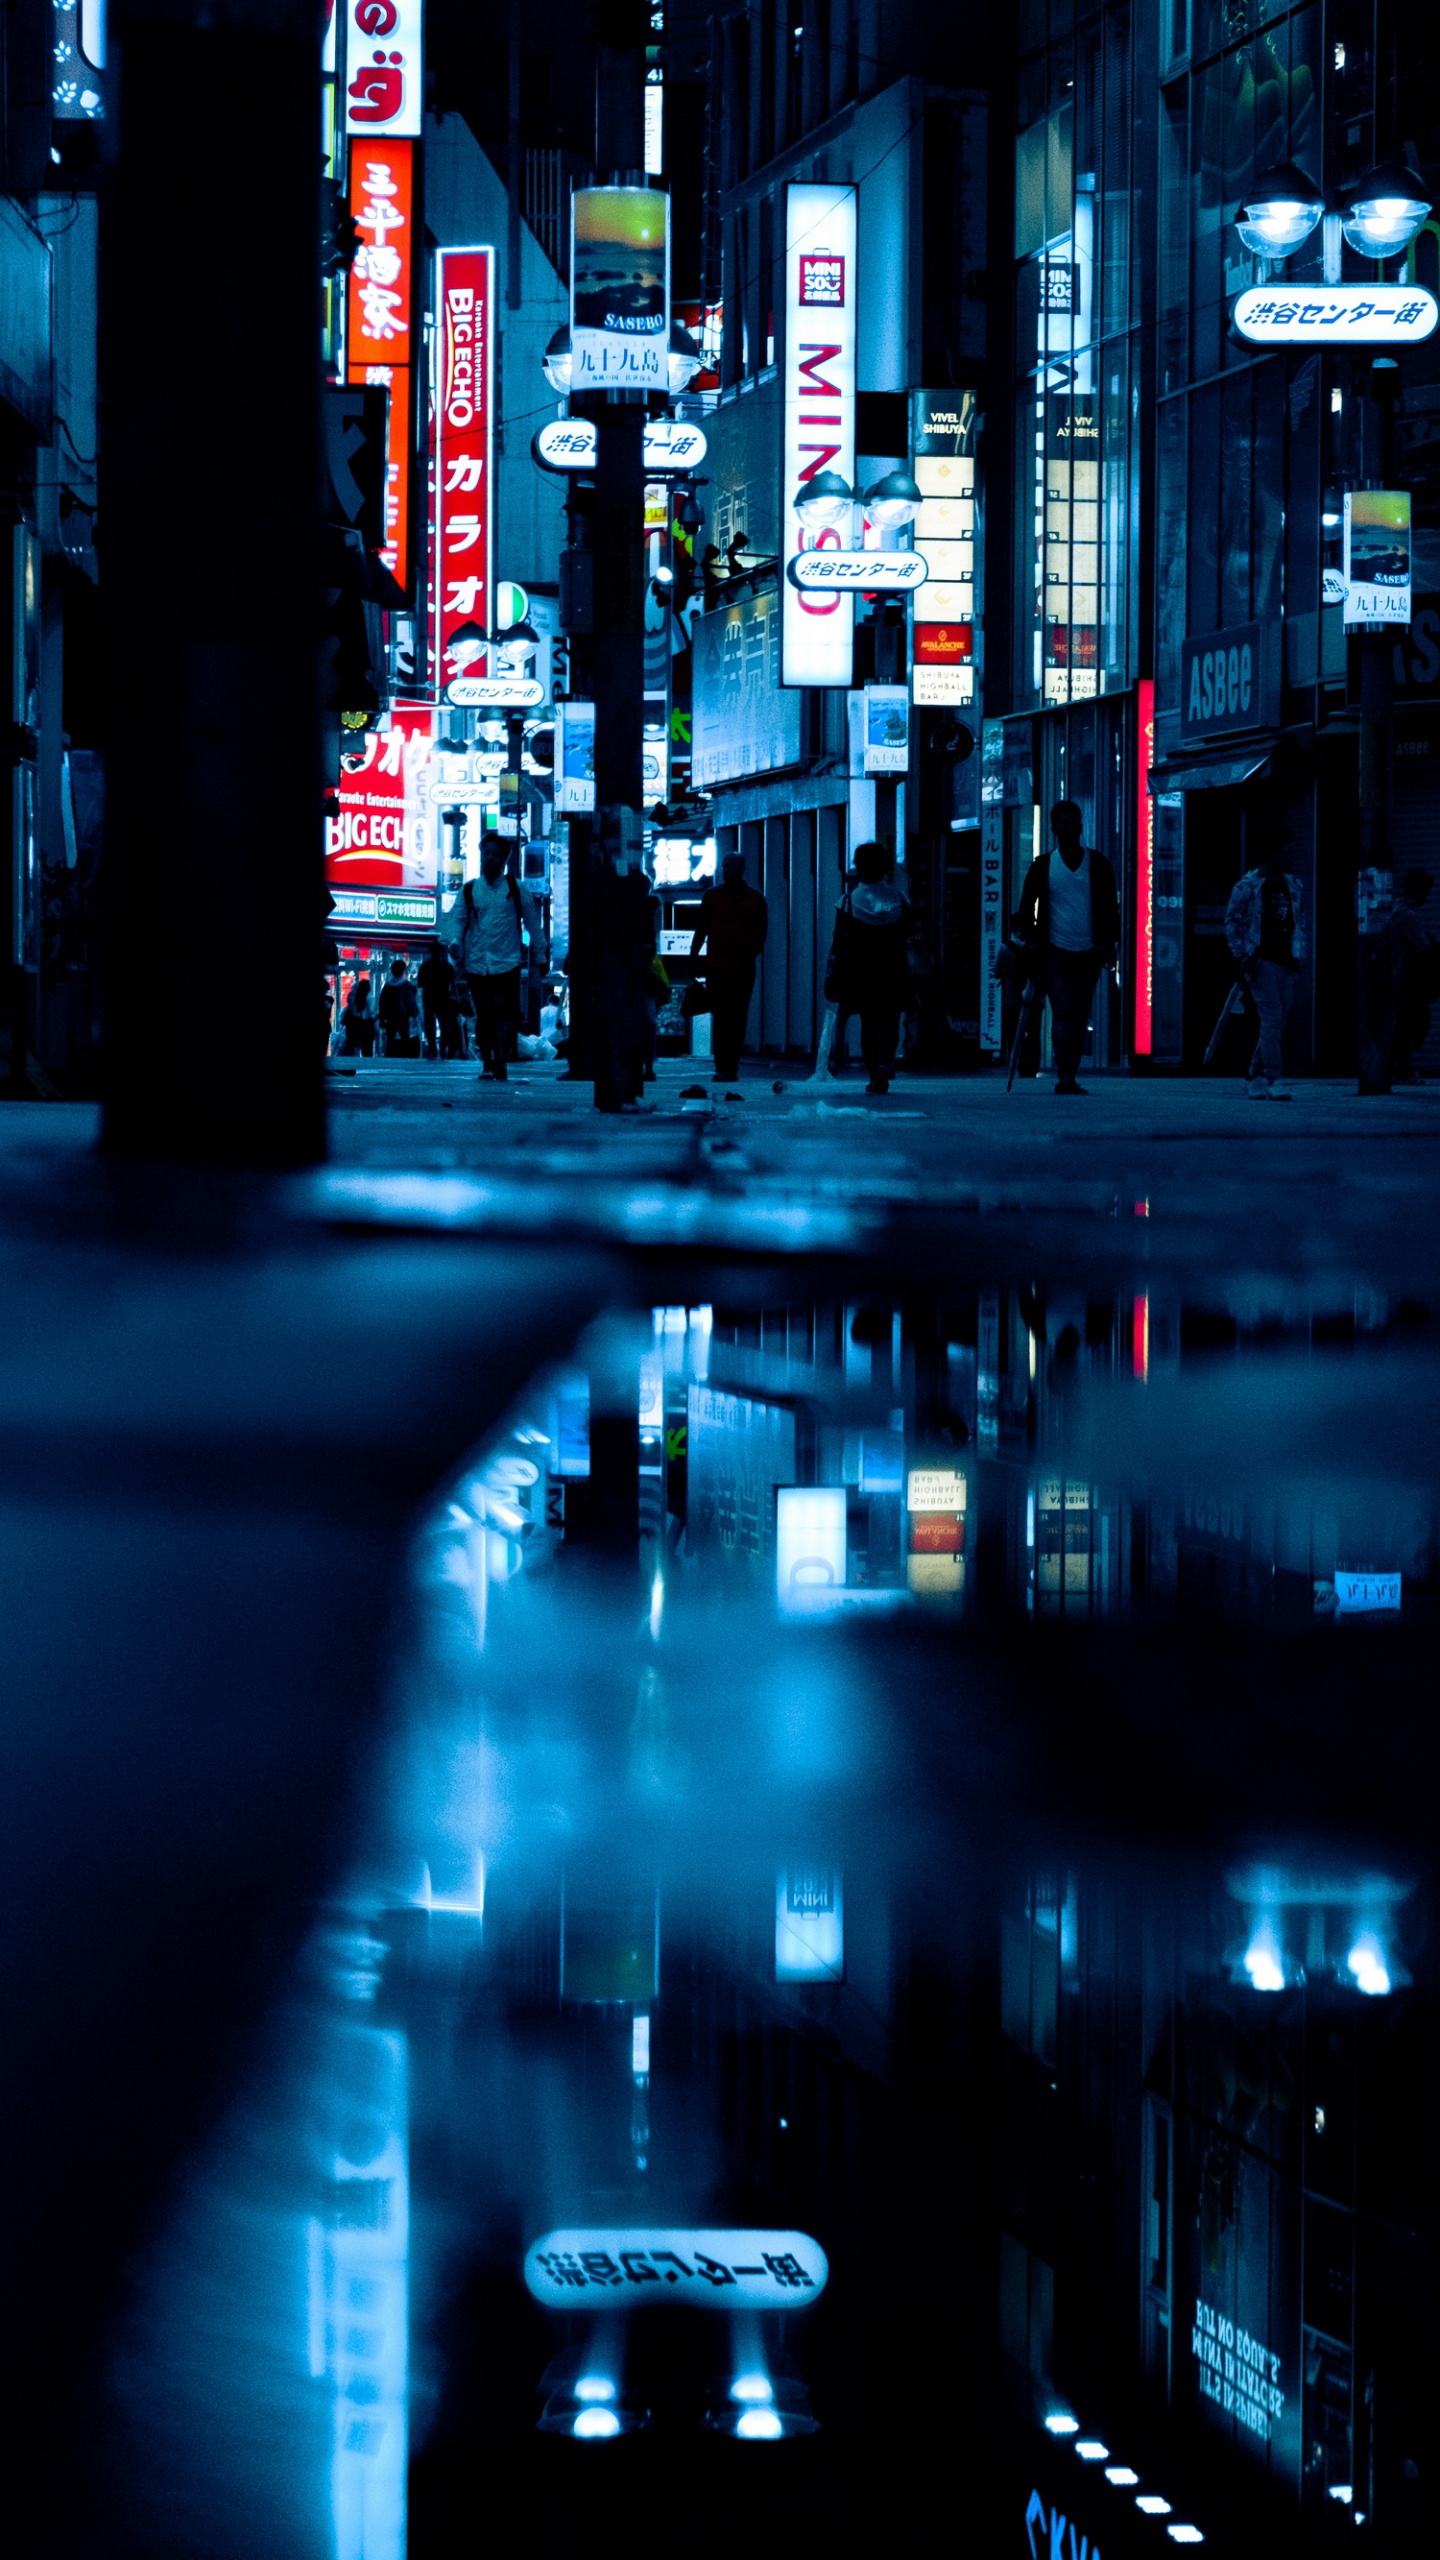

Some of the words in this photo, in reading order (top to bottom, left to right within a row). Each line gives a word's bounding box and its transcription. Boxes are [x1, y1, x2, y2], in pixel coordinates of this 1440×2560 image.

[804, 261, 841, 275] MINI
[448, 288, 474, 343] BIG
[474, 300, 483, 339] Karaoke
[604, 313, 663, 330] SASEBO
[1244, 302, 1429, 325] 渋谷センター街
[578, 347, 660, 374] 九十九島
[474, 342, 483, 411] Entertainment
[448, 347, 474, 428] ECHO
[930, 412, 959, 423] VIVEL
[922, 424, 967, 434] SHIBUYA
[801, 562, 919, 577] 渋谷センター街
[1355, 595, 1408, 613] 九十九島
[920, 641, 965, 650] AVALANCHE
[920, 671, 960, 679] SHIBUYA
[920, 683, 967, 691] HIGHBALL
[369, 815, 432, 862] ECHO
